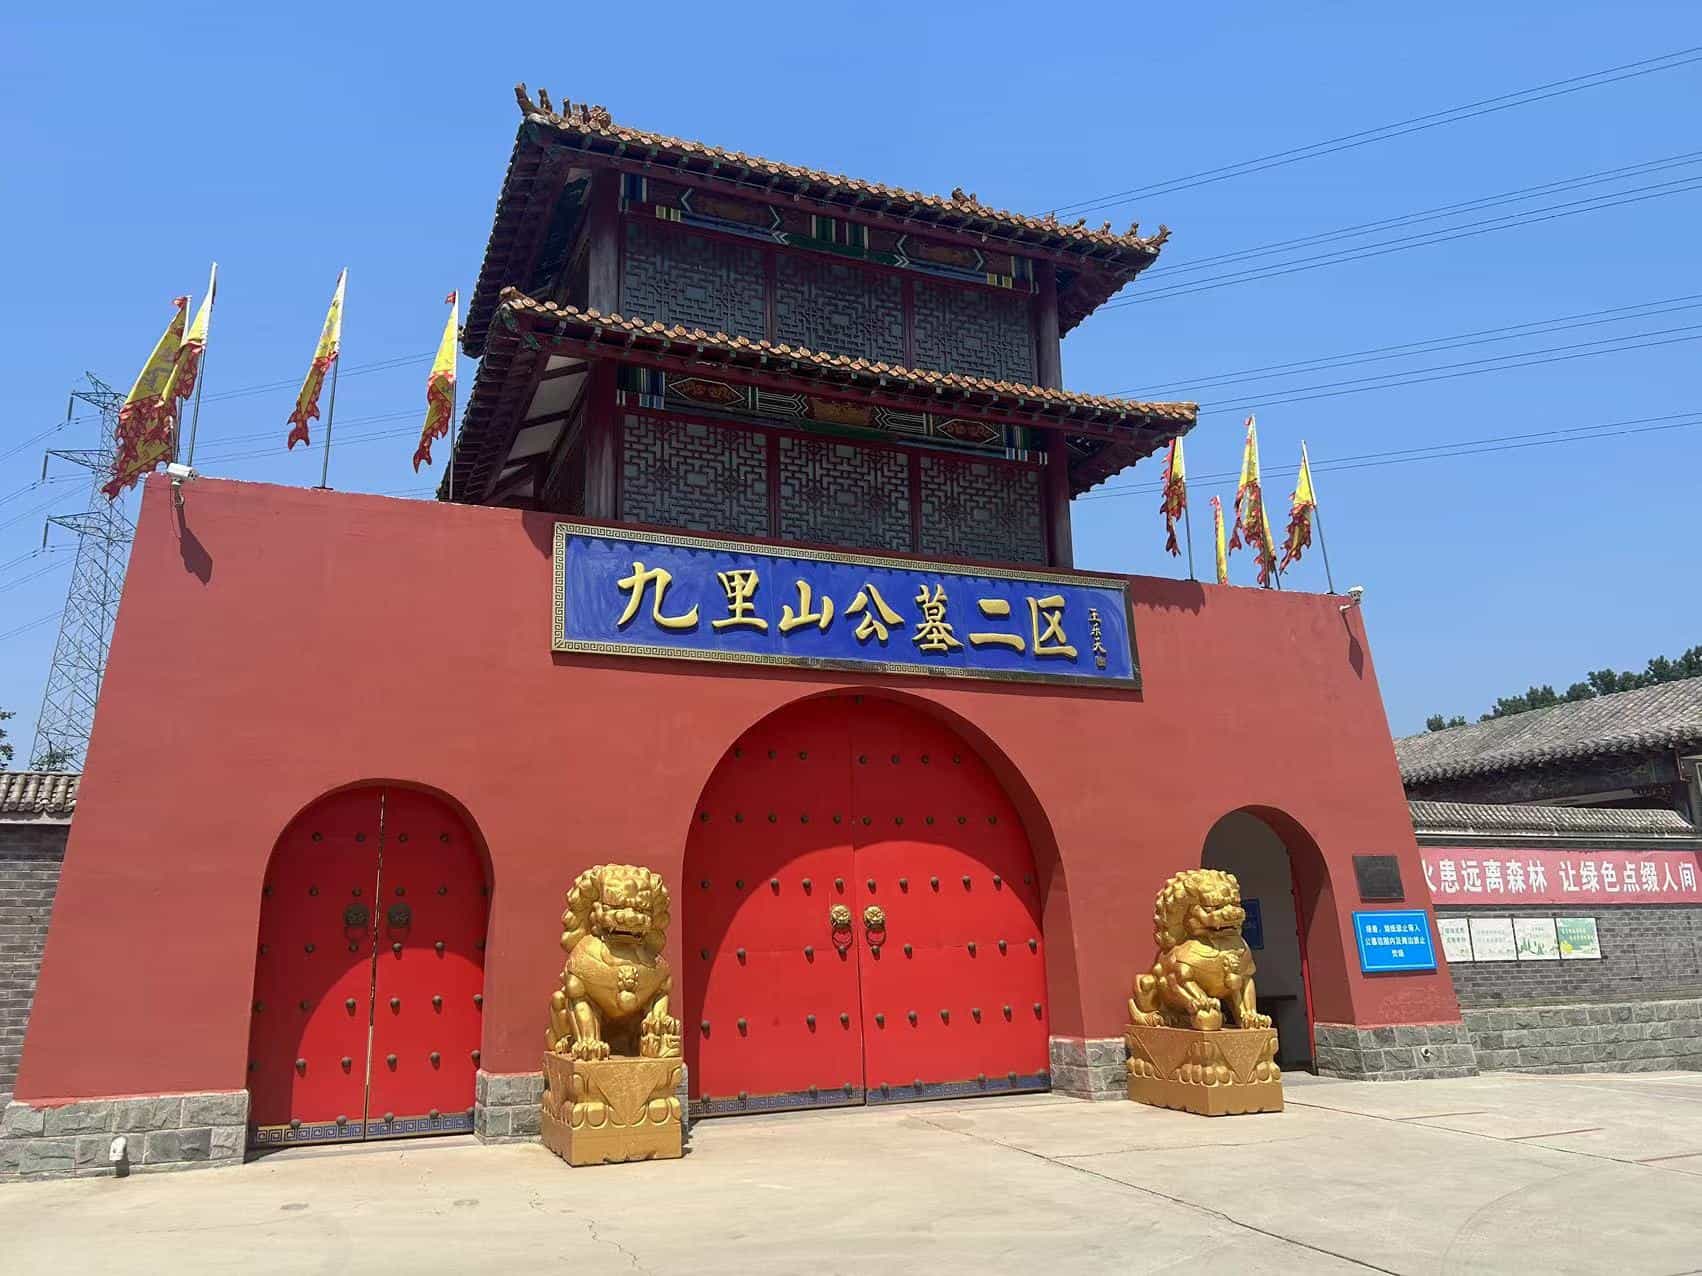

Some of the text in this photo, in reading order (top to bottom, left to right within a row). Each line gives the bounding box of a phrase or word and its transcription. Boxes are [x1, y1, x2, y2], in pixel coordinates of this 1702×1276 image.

[616, 561, 1079, 660] 九里山公墓二区
[1559, 860, 1697, 892] 让绿色点缀人间
